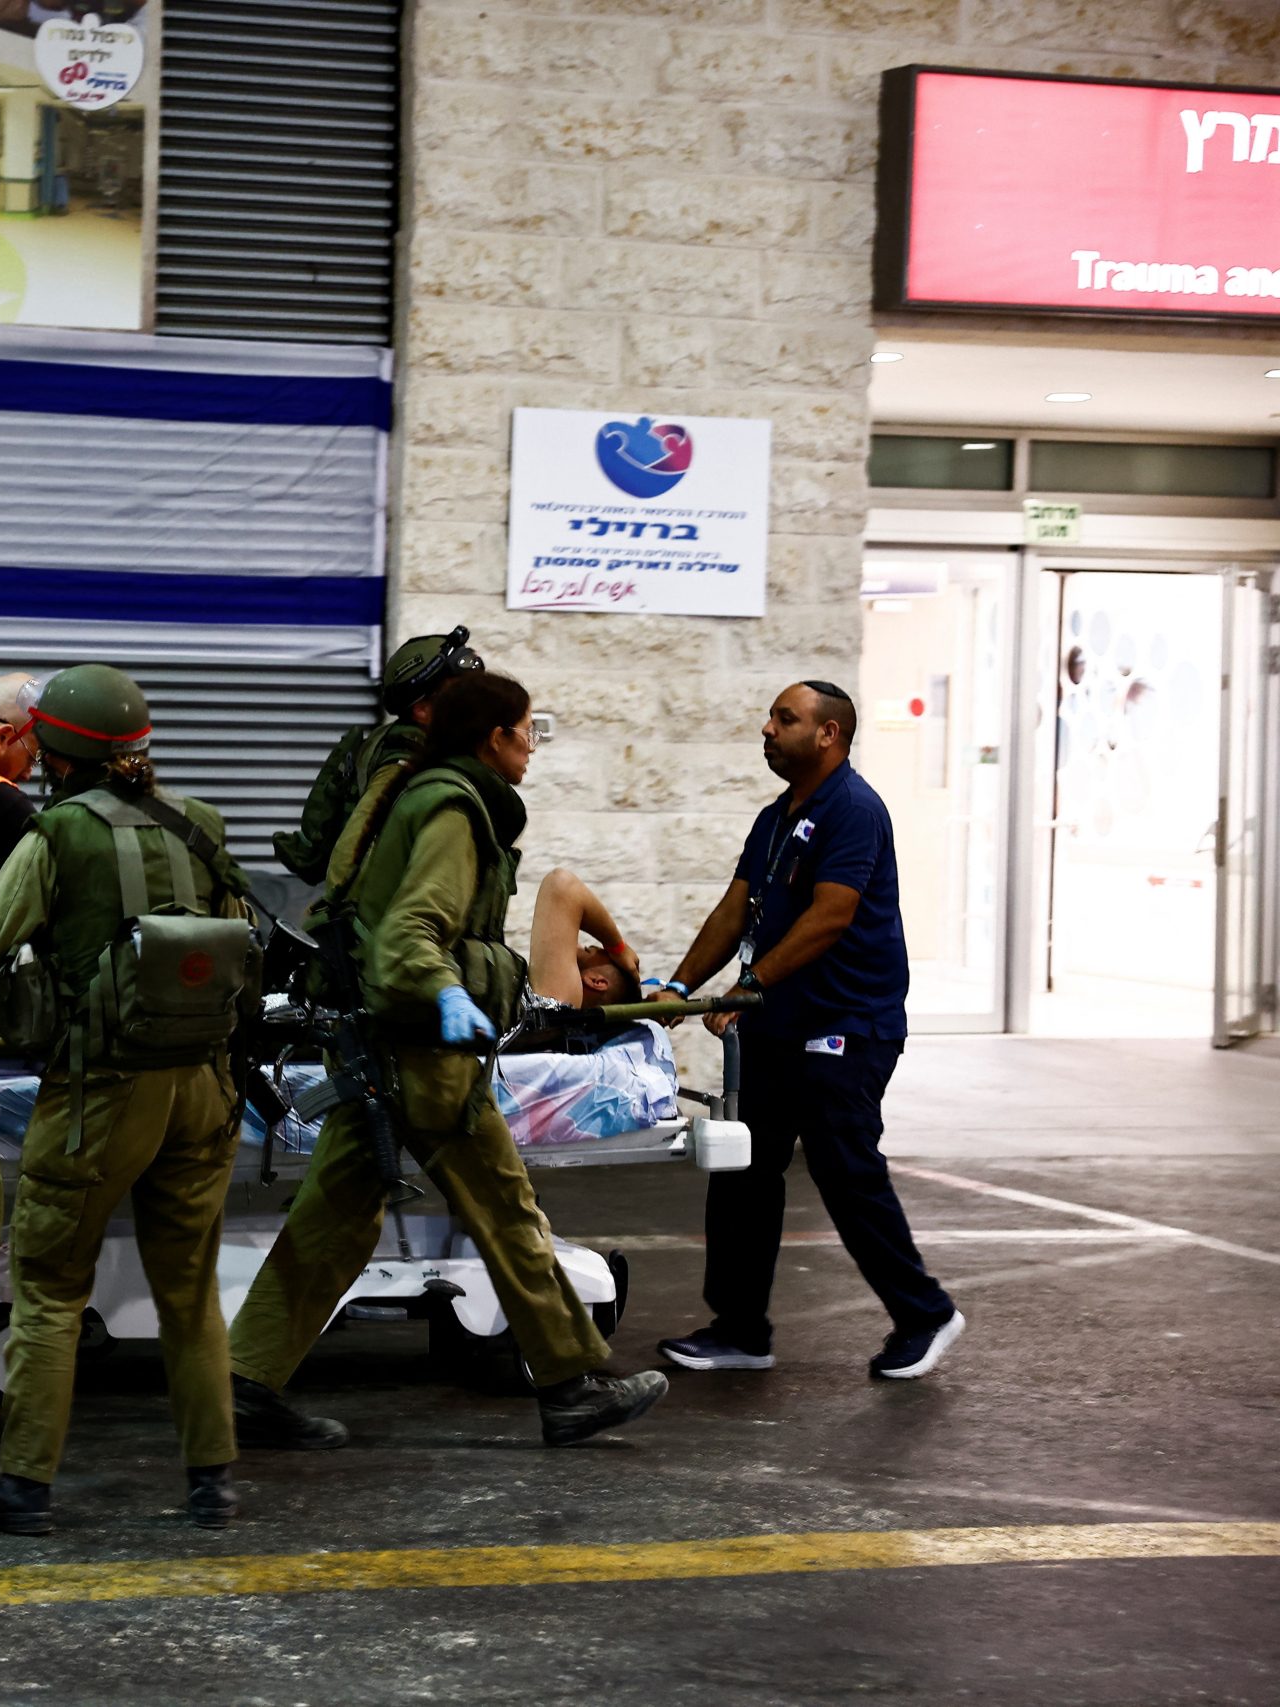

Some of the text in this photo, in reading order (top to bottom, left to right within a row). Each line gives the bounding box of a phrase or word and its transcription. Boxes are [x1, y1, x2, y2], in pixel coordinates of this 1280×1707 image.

[59, 62, 88, 84] 60
[1071, 250, 1219, 295] Trauma
[567, 517, 699, 540] ברזילי
[532, 555, 740, 573] שילה ואריק סמסון
